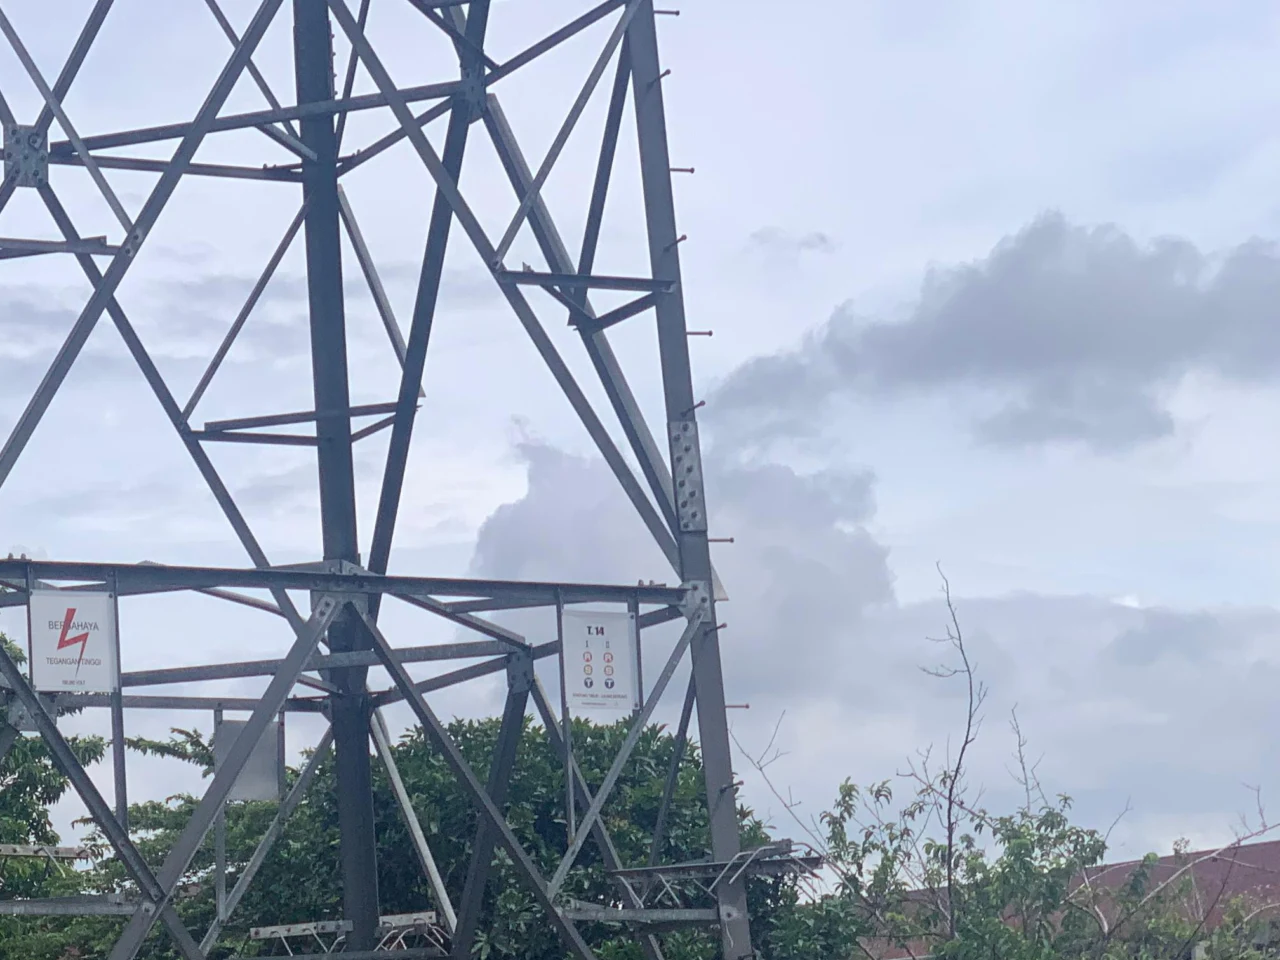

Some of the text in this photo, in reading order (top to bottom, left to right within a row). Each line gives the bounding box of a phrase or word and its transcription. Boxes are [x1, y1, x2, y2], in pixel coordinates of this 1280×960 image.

[48, 620, 99, 631] BERAHAYA
[46, 657, 102, 666] TEGANGAN TINGGI
